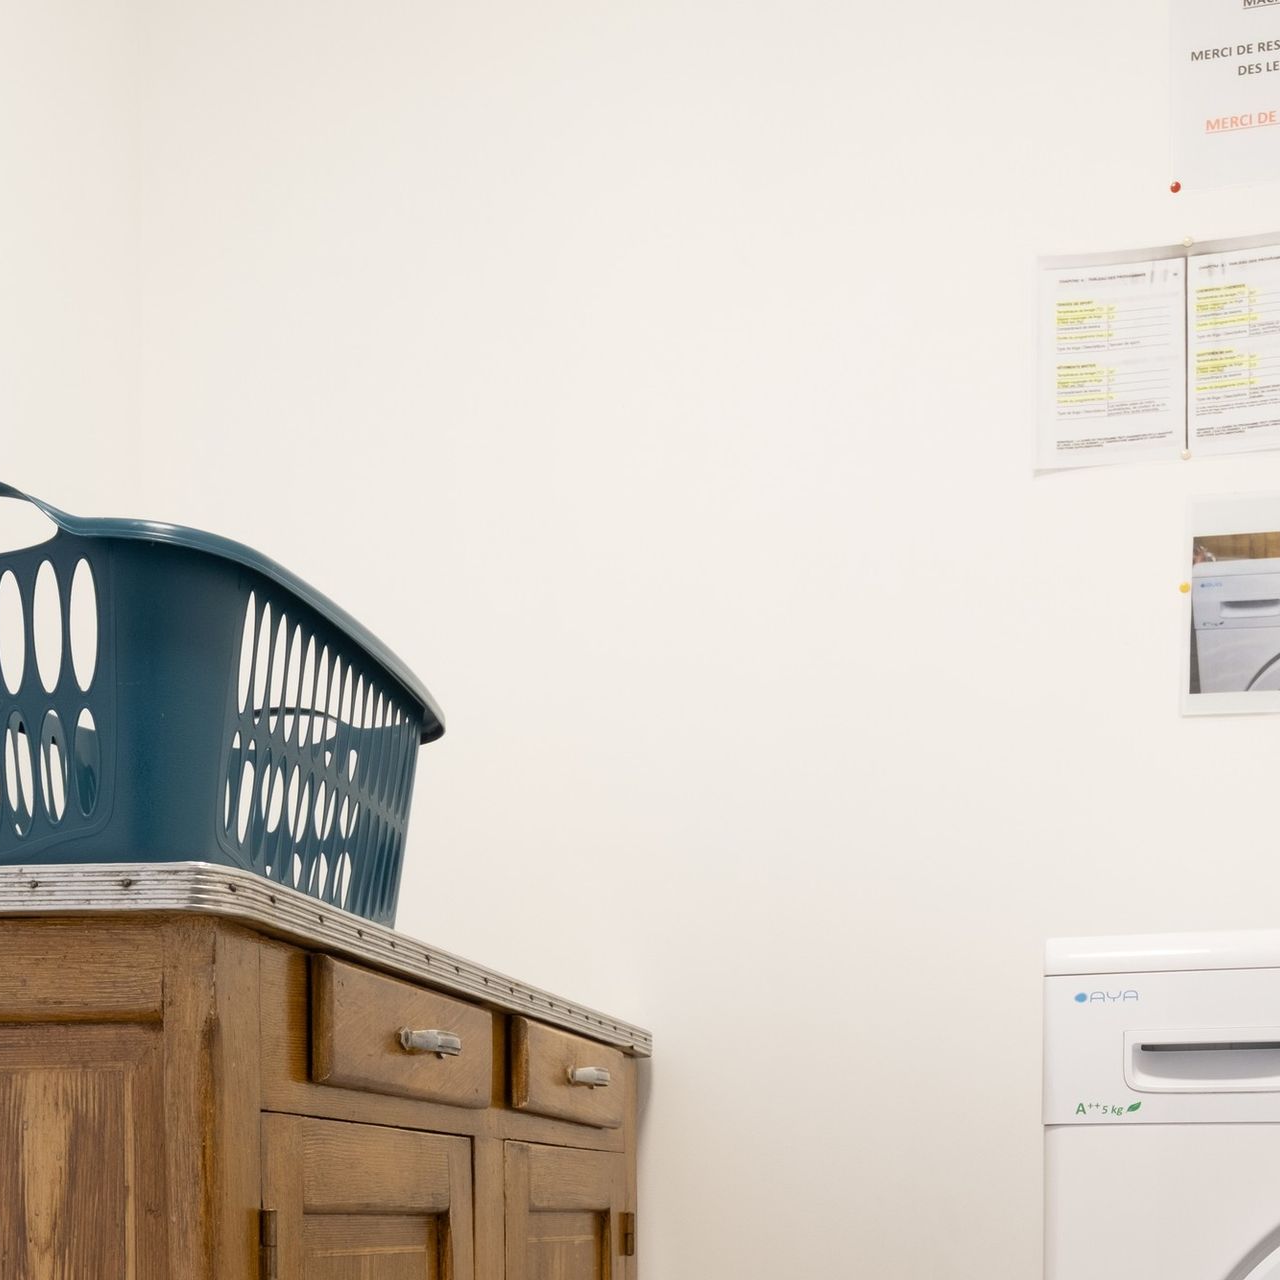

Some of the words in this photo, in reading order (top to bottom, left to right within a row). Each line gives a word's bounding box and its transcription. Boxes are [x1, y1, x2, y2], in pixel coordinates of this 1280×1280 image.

[1190, 46, 1233, 61] MERCI
[1237, 43, 1253, 56] DE
[1238, 63, 1262, 76] DES
[1205, 114, 1253, 131] MERCI
[1257, 110, 1278, 125] DE
[1090, 990, 1138, 1002] AYA
[1111, 1105, 1123, 1116] kg
